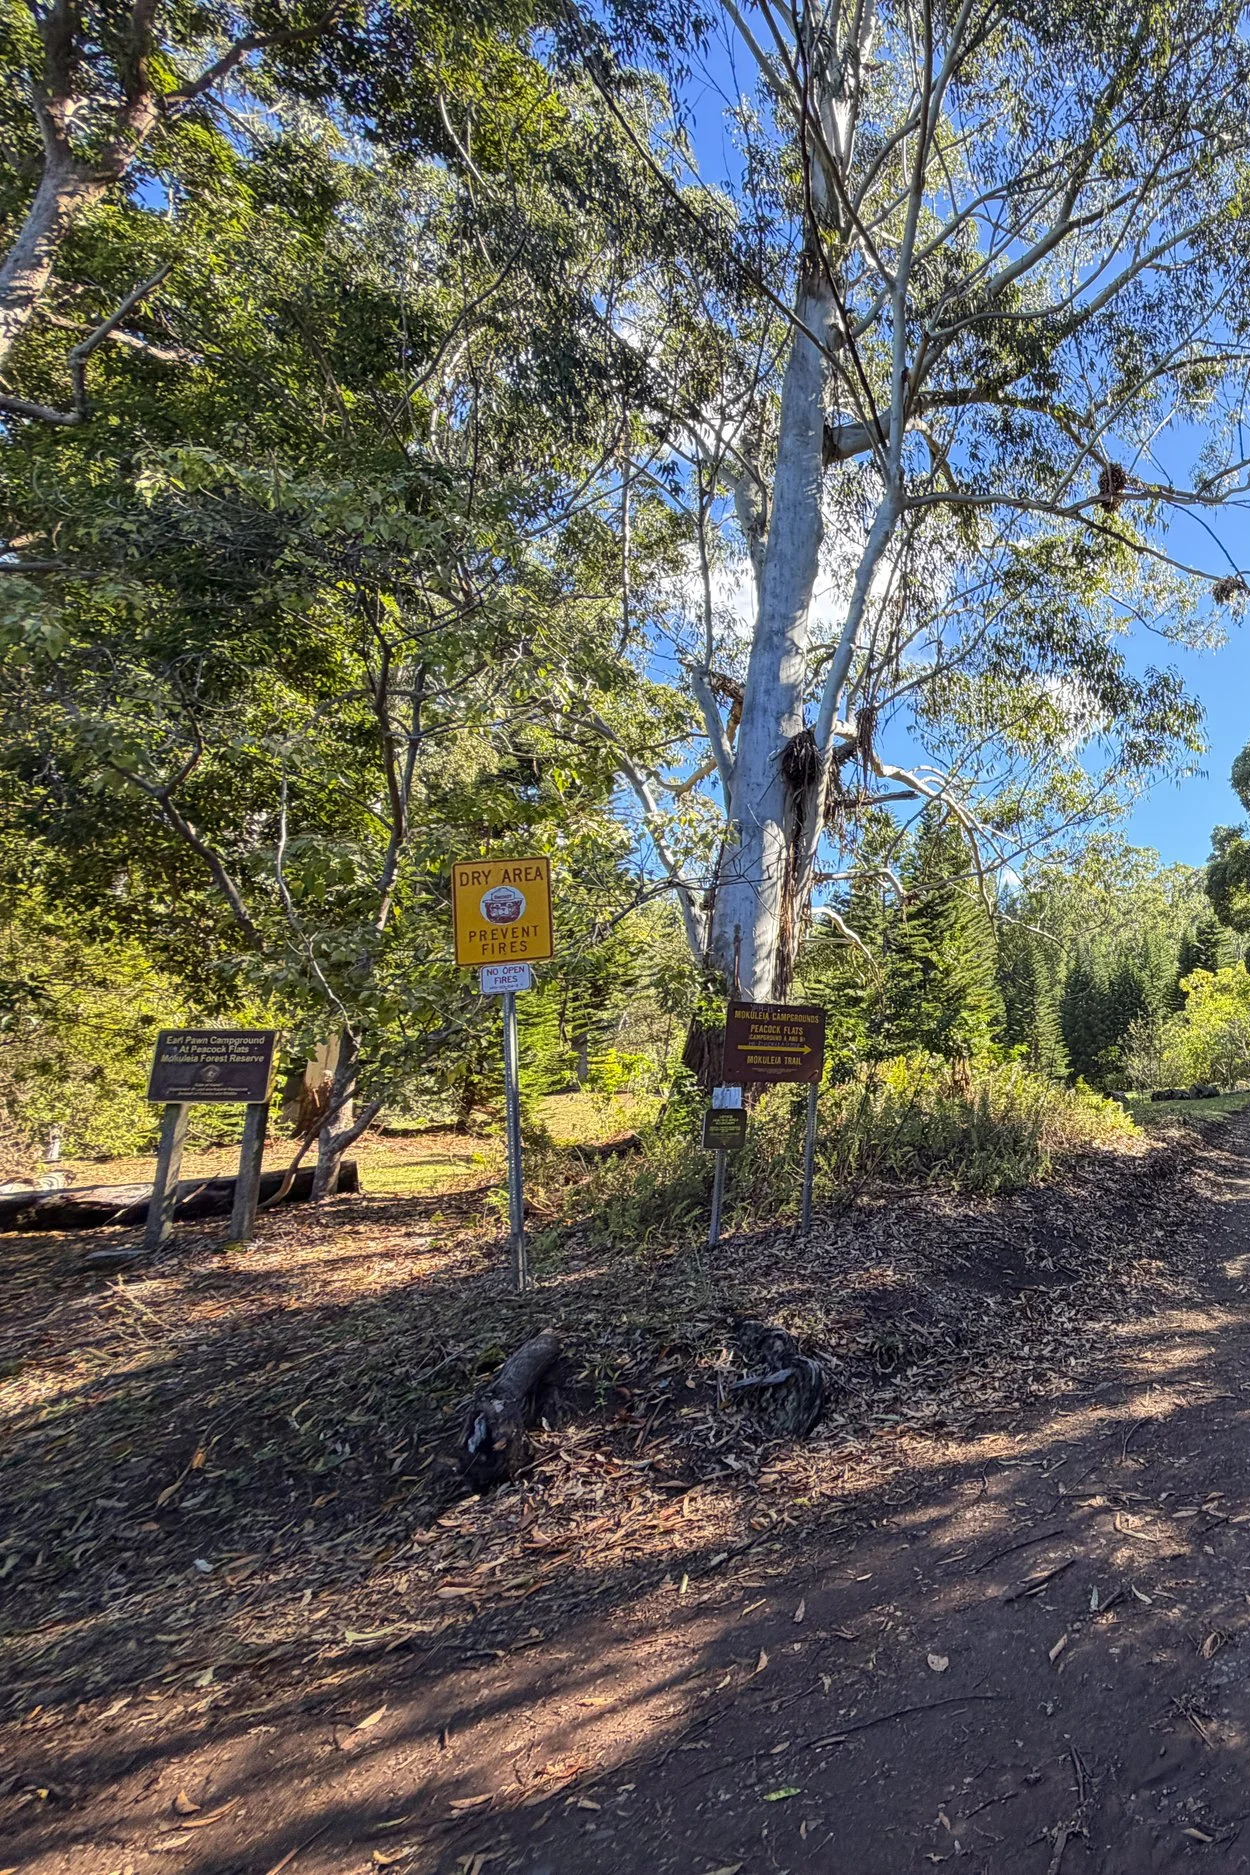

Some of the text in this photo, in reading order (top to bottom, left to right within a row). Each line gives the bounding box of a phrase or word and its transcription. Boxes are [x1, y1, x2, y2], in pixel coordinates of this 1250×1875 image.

[460, 866, 543, 887] DRY AREA
[469, 925, 539, 942] PREVENT
[482, 941, 527, 955] FIRES
[487, 966, 525, 976] NO OPEN
[495, 976, 518, 985] FIRES
[735, 1010, 819, 1023] MOKULEIA CAMPGROUNDS
[751, 1025, 804, 1035] PEACOCK FLATS
[166, 1036, 265, 1047] Earl Pawn Campground
[179, 1045, 249, 1053] At Peacock Flats
[747, 1055, 802, 1065] MOKULEIA TRAIL
